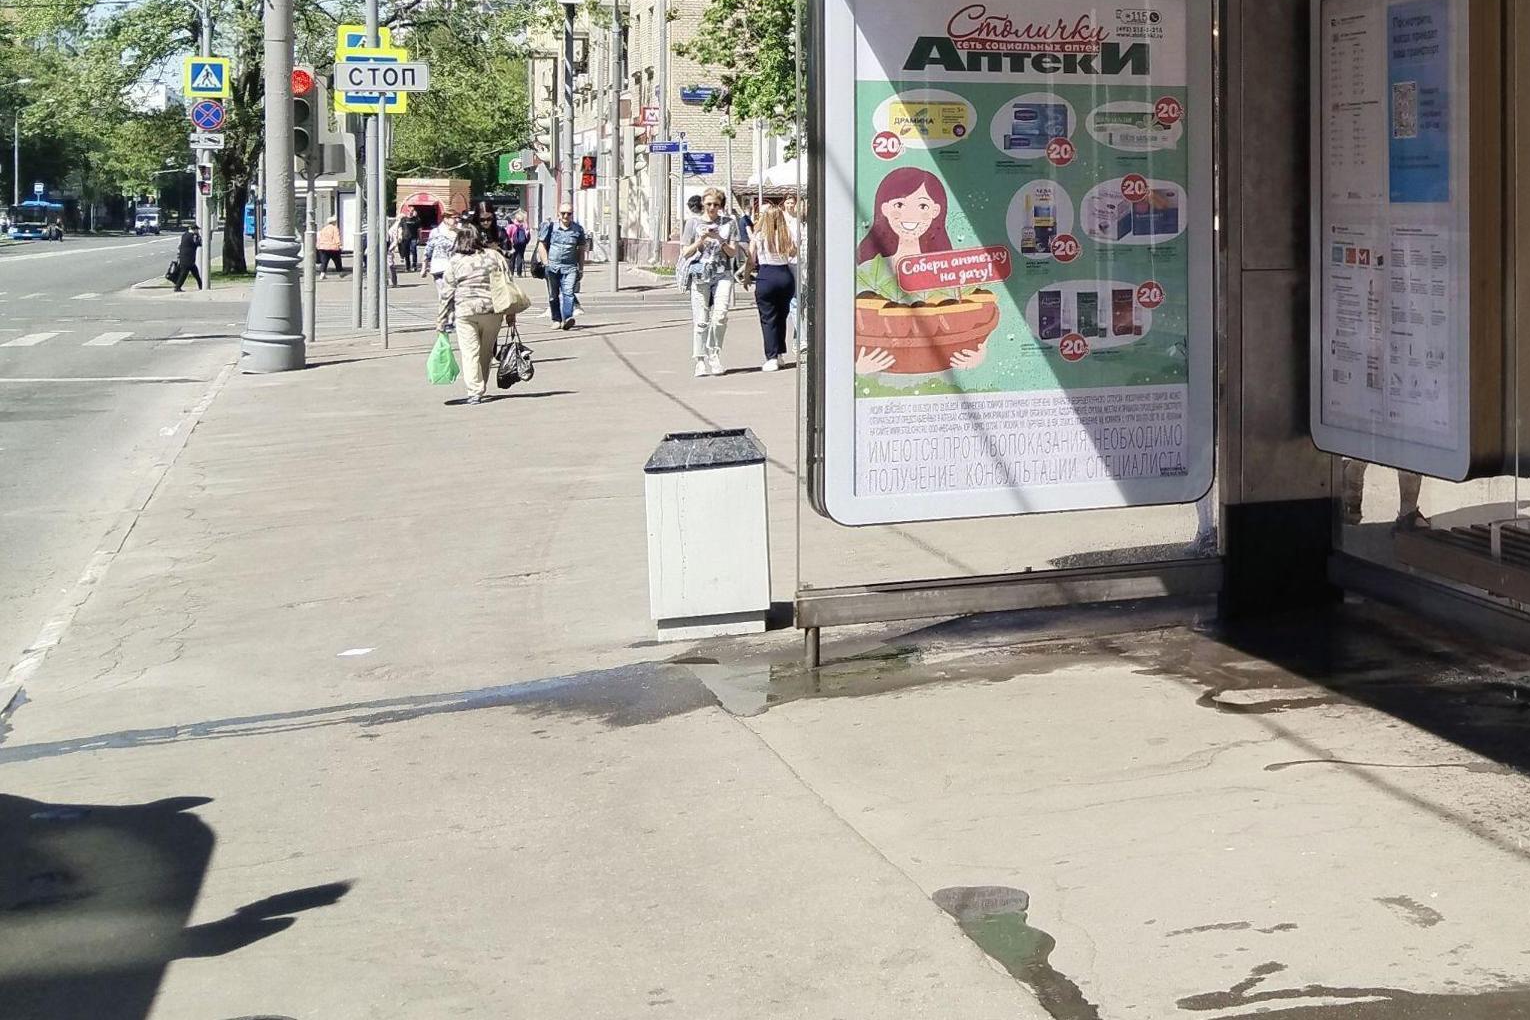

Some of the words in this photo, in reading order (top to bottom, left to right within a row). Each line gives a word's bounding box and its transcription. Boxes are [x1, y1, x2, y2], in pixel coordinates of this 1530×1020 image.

[947, 4, 1110, 42] Столички
[957, 40, 983, 50] сеть
[985, 42, 1061, 52] социальных
[1064, 43, 1100, 53] аптек
[348, 67, 416, 86] СТОП
[902, 258, 948, 275] Собери
[951, 250, 1007, 264] аптечку
[940, 271, 956, 282] на
[959, 263, 993, 284] дачу!
[869, 437, 938, 463] ИМЕЮТСЯ
[1094, 424, 1183, 452] НЕОБХОДИМО
[869, 465, 957, 492] ПОЛУЧЕНИЕ
[966, 457, 1077, 487] КОНСУЛЬТАЦИИ
